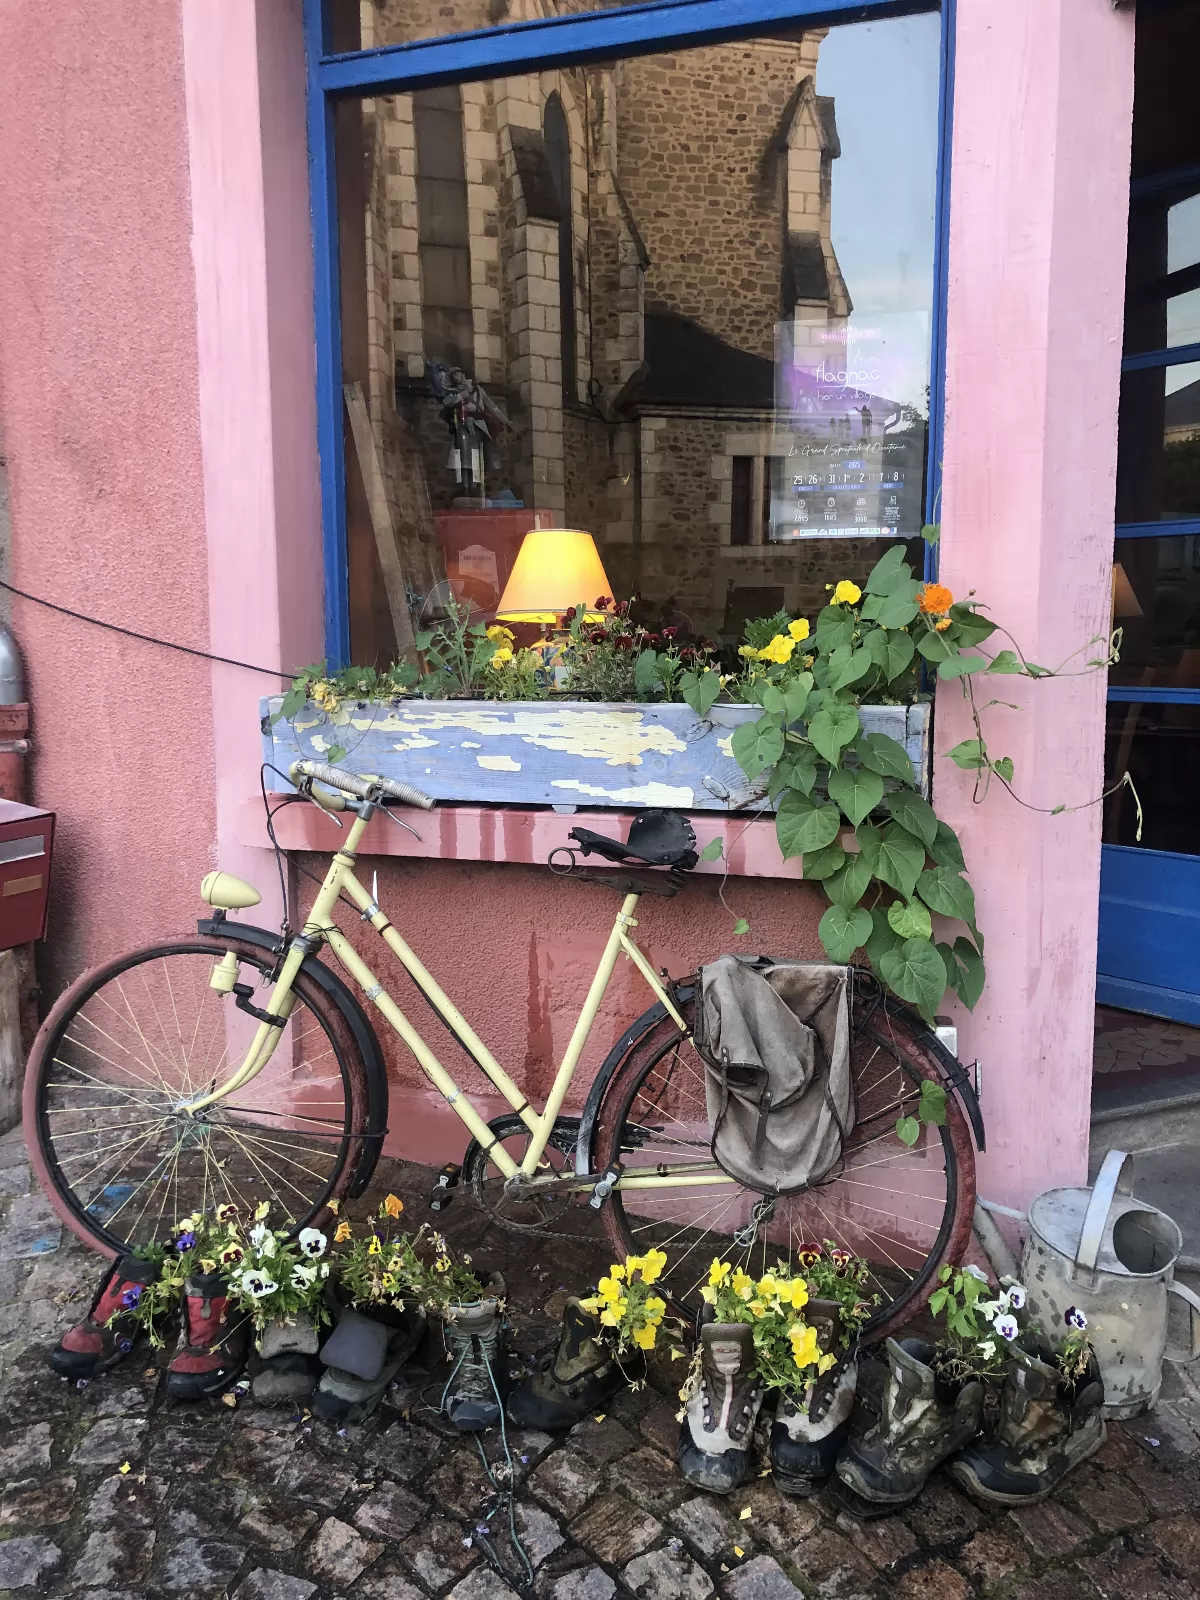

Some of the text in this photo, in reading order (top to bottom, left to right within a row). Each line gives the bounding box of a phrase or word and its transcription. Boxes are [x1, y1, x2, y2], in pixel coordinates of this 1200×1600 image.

[815, 360, 881, 393] flagnac
[817, 389, 833, 401] hier
[835, 392, 846, 400] un
[788, 444, 799, 457] Le
[801, 444, 828, 457] Grand
[848, 461, 861, 469] 2025
[793, 475, 802, 485] 25
[808, 474, 818, 485] 26
[828, 474, 836, 484] 31
[859, 472, 865, 483] 2
[879, 472, 884, 482] 7
[893, 471, 899, 482] 8
